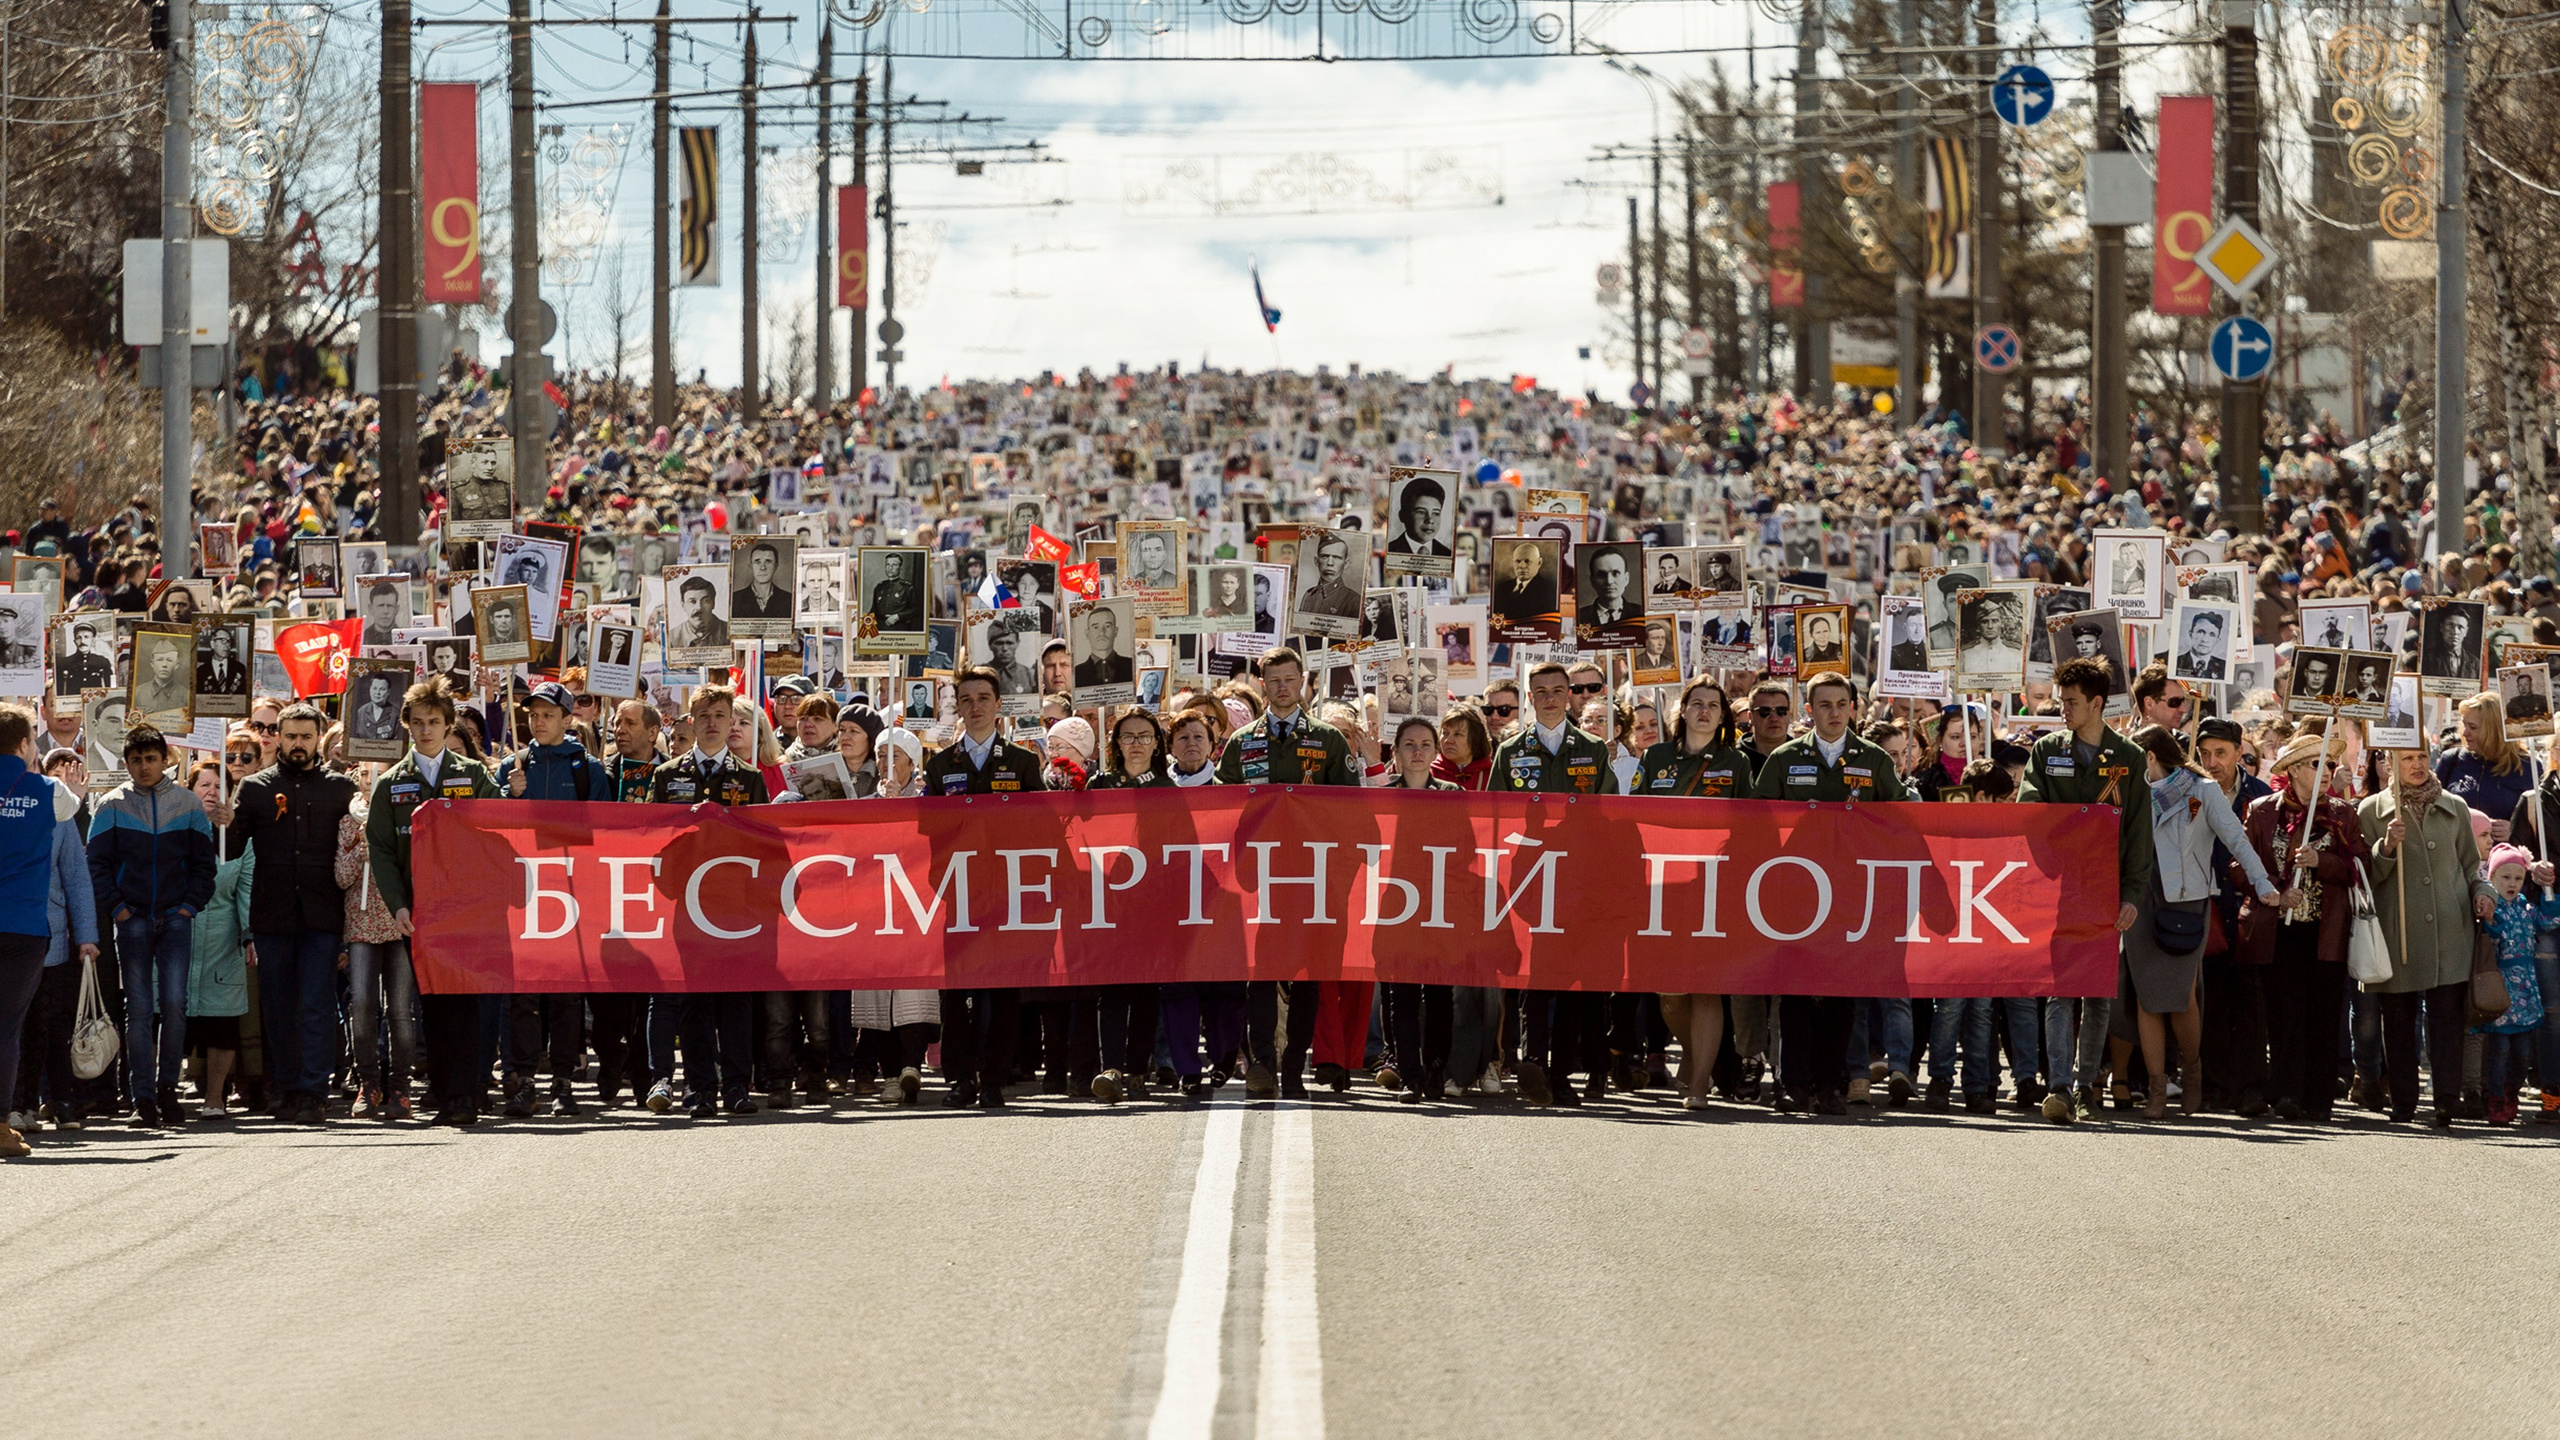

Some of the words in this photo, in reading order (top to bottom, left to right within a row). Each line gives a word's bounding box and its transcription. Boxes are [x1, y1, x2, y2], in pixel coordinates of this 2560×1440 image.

[430, 197, 479, 280] 9
[840, 248, 867, 299] 9
[1515, 651, 1535, 661] ПТР
[1534, 651, 1580, 664] НИЛАЕВИЧ
[1550, 642, 1580, 655] АРПОВ
[1897, 671, 1931, 680] Прокопьев
[515, 833, 1568, 940] БЕССМЕРТНЫЙ
[1638, 853, 2030, 943] ПОЛК
